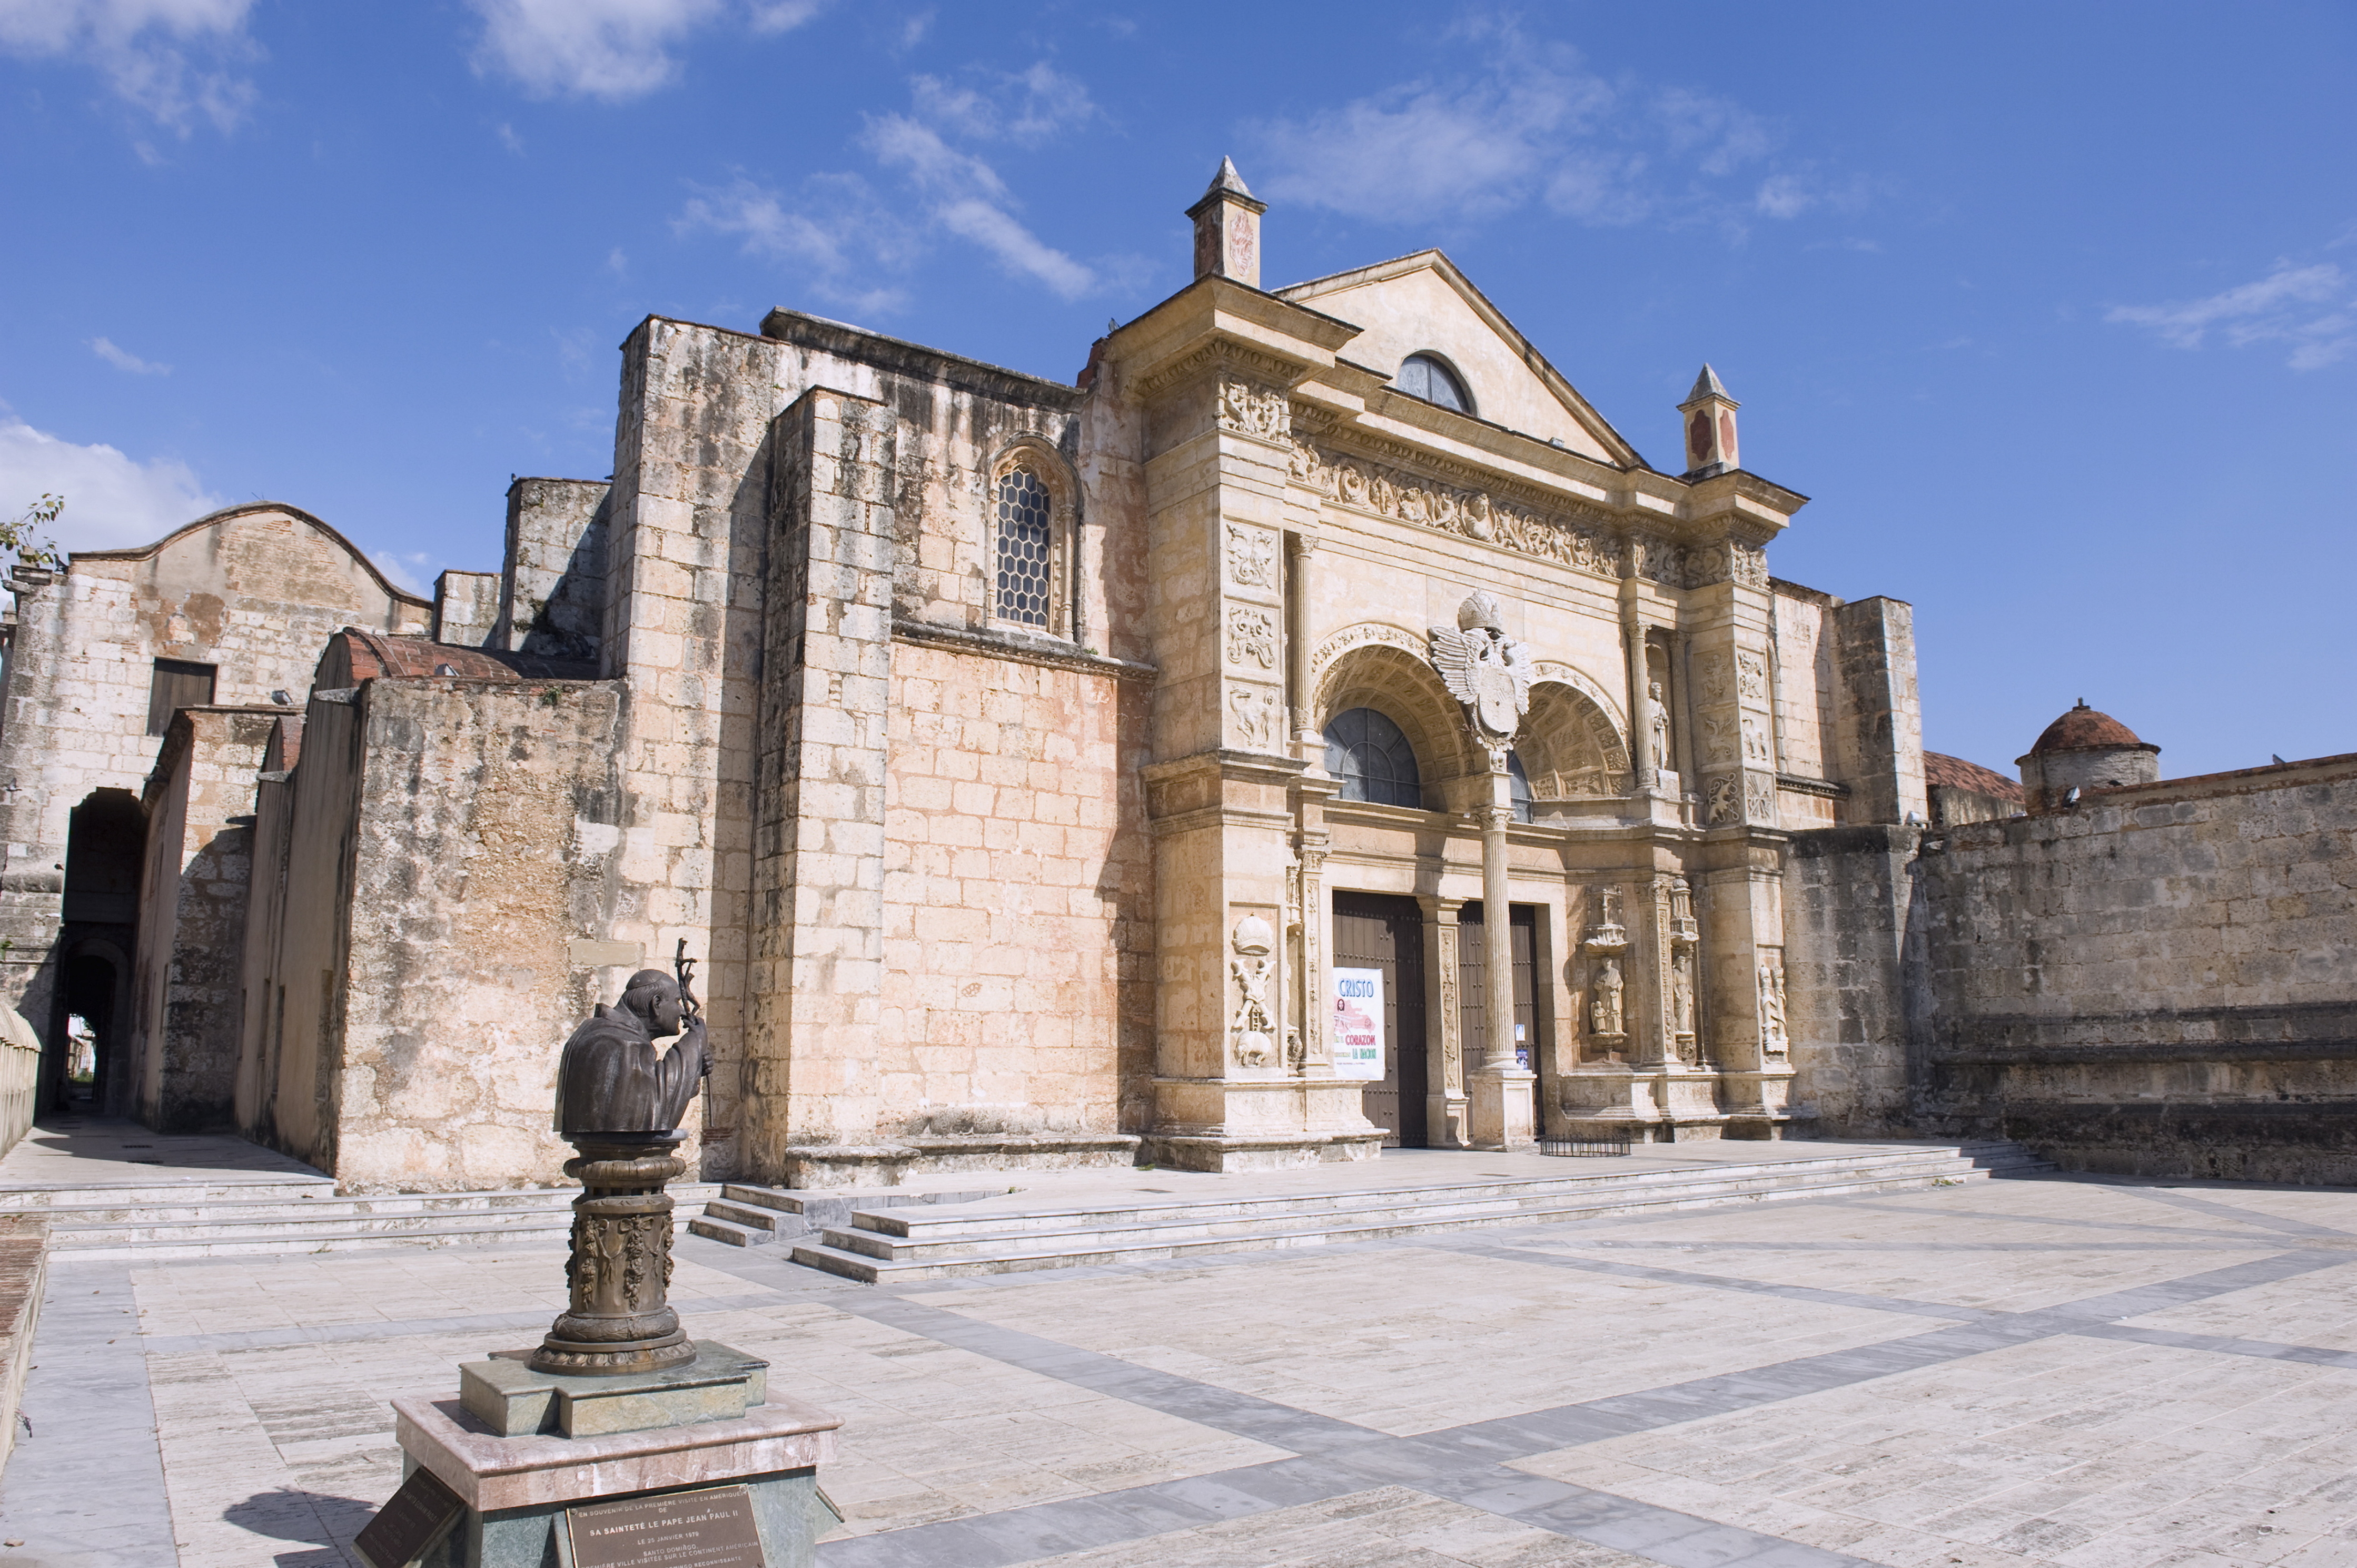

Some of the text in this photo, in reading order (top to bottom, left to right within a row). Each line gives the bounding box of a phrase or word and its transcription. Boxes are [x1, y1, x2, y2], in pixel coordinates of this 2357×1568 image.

[1338, 978, 1374, 997] CRISTO
[1345, 1035, 1376, 1045] CORAZON
[590, 1507, 623, 1516] SOUVENIR
[604, 1522, 646, 1535] SAINTETÉ
[662, 1518, 683, 1526] PAPE
[686, 1515, 707, 1523] JEAN
[710, 1511, 730, 1520] PAUL
[657, 1534, 683, 1542] JANVIER
[637, 1555, 662, 1564] VISITÉE
[689, 1546, 724, 1556] CONTINENT
